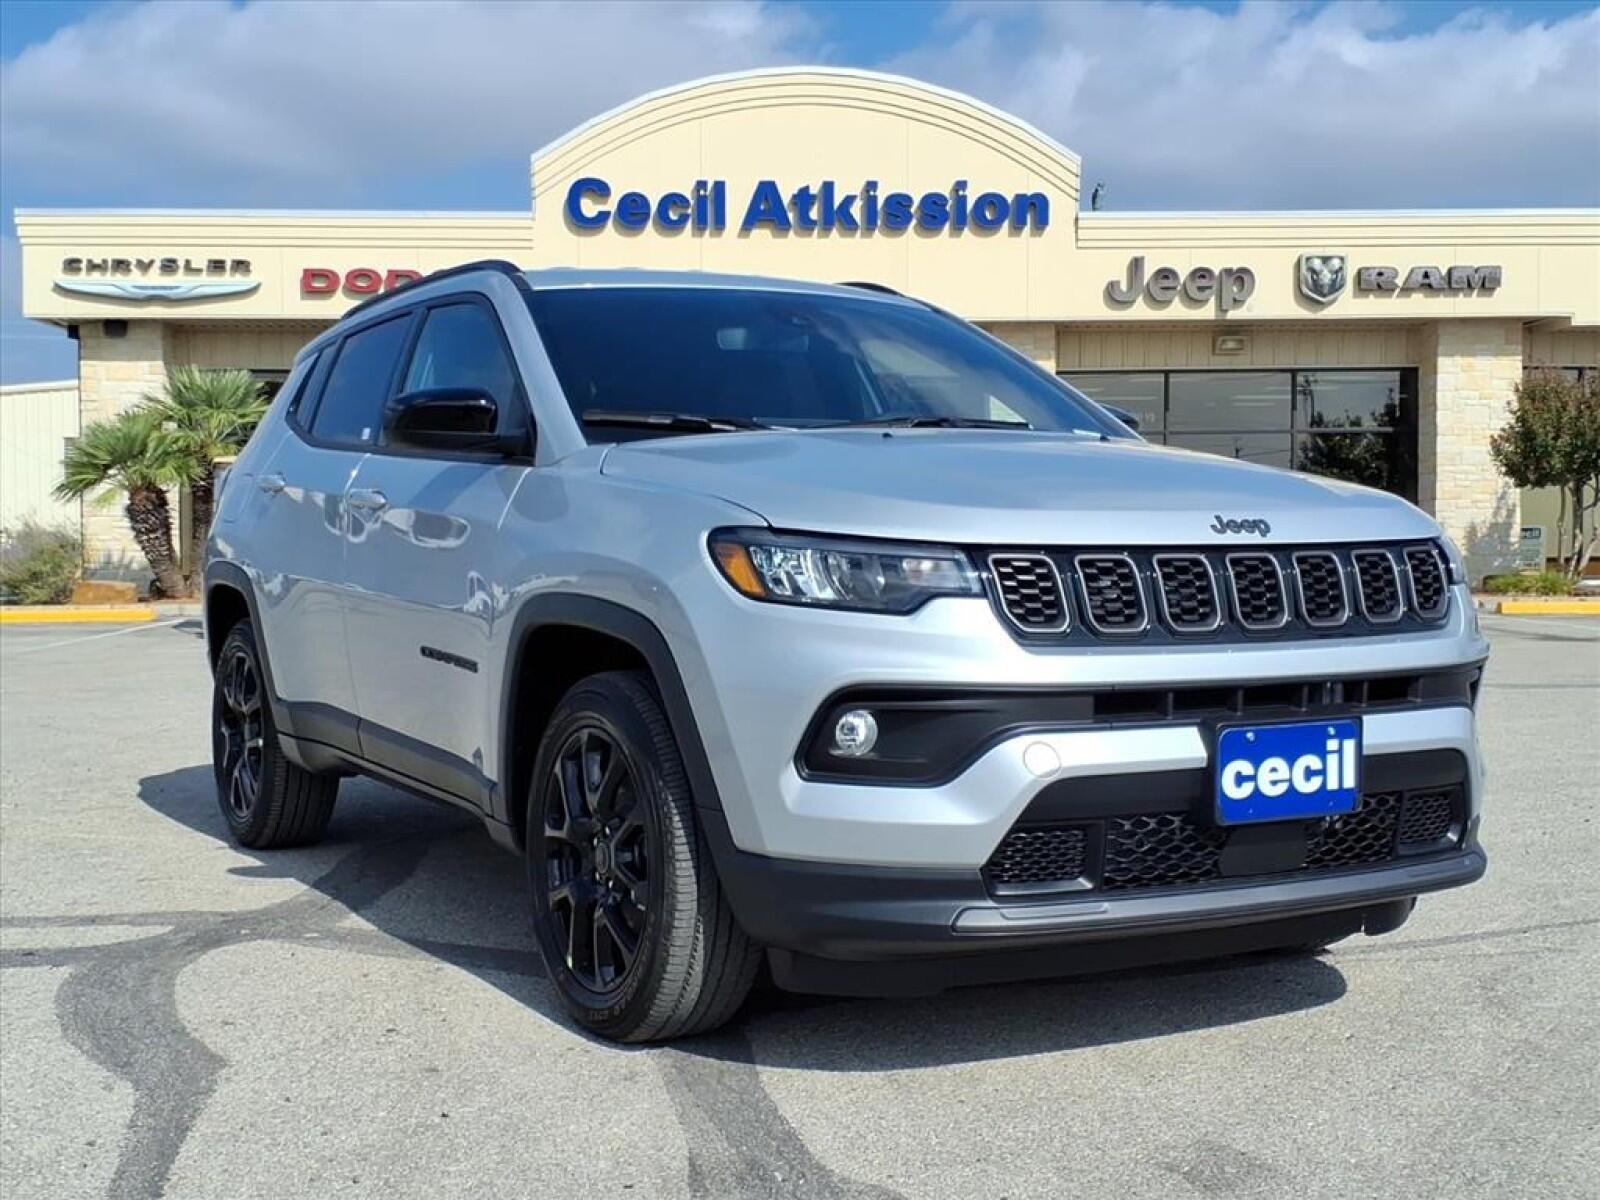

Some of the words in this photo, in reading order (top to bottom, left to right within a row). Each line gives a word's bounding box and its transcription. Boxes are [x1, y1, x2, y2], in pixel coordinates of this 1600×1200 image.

[565, 177, 726, 231] Cecil
[742, 179, 1050, 231] Atkission
[63, 257, 251, 275] CHRYSLER
[1107, 256, 1256, 311] Jeep
[1357, 264, 1502, 292] RAM
[1211, 515, 1271, 537] Jeep
[1221, 738, 1356, 800] cecil
